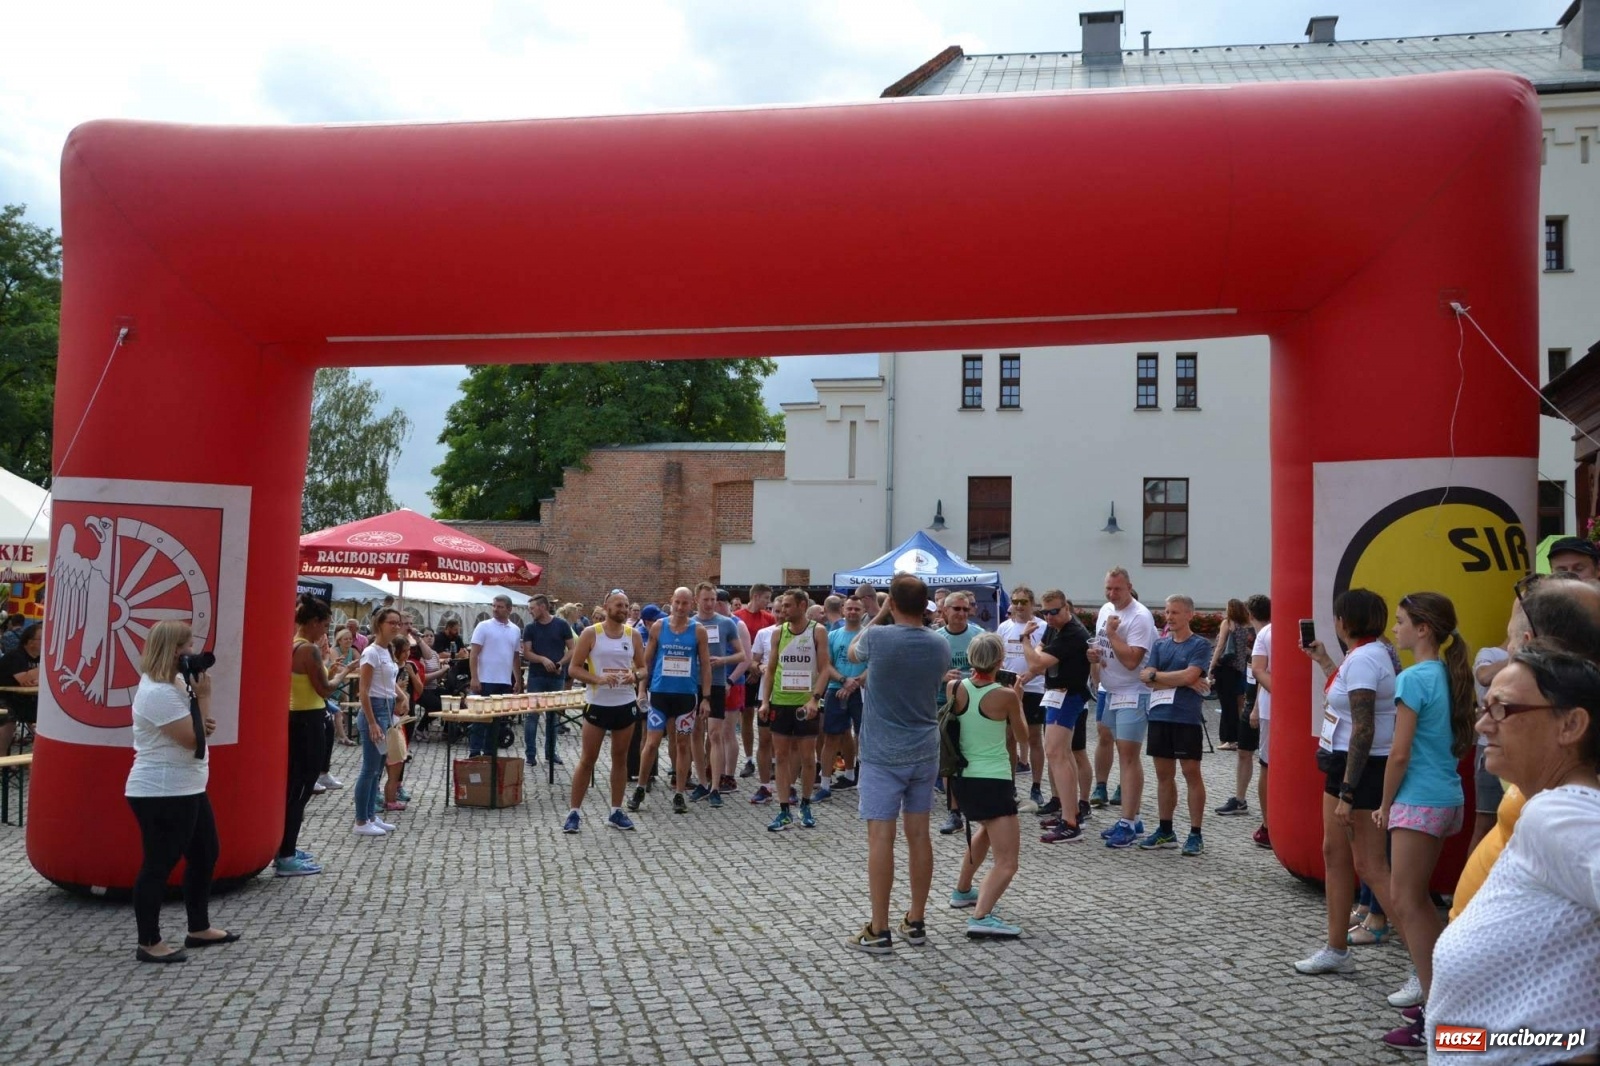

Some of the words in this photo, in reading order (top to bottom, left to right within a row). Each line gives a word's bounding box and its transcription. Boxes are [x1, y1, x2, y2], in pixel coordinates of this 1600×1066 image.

[317, 550, 410, 565] RACIBORSKIE
[437, 556, 515, 574] RACIBORSKIE
[928, 575, 978, 584] TERENOWY
